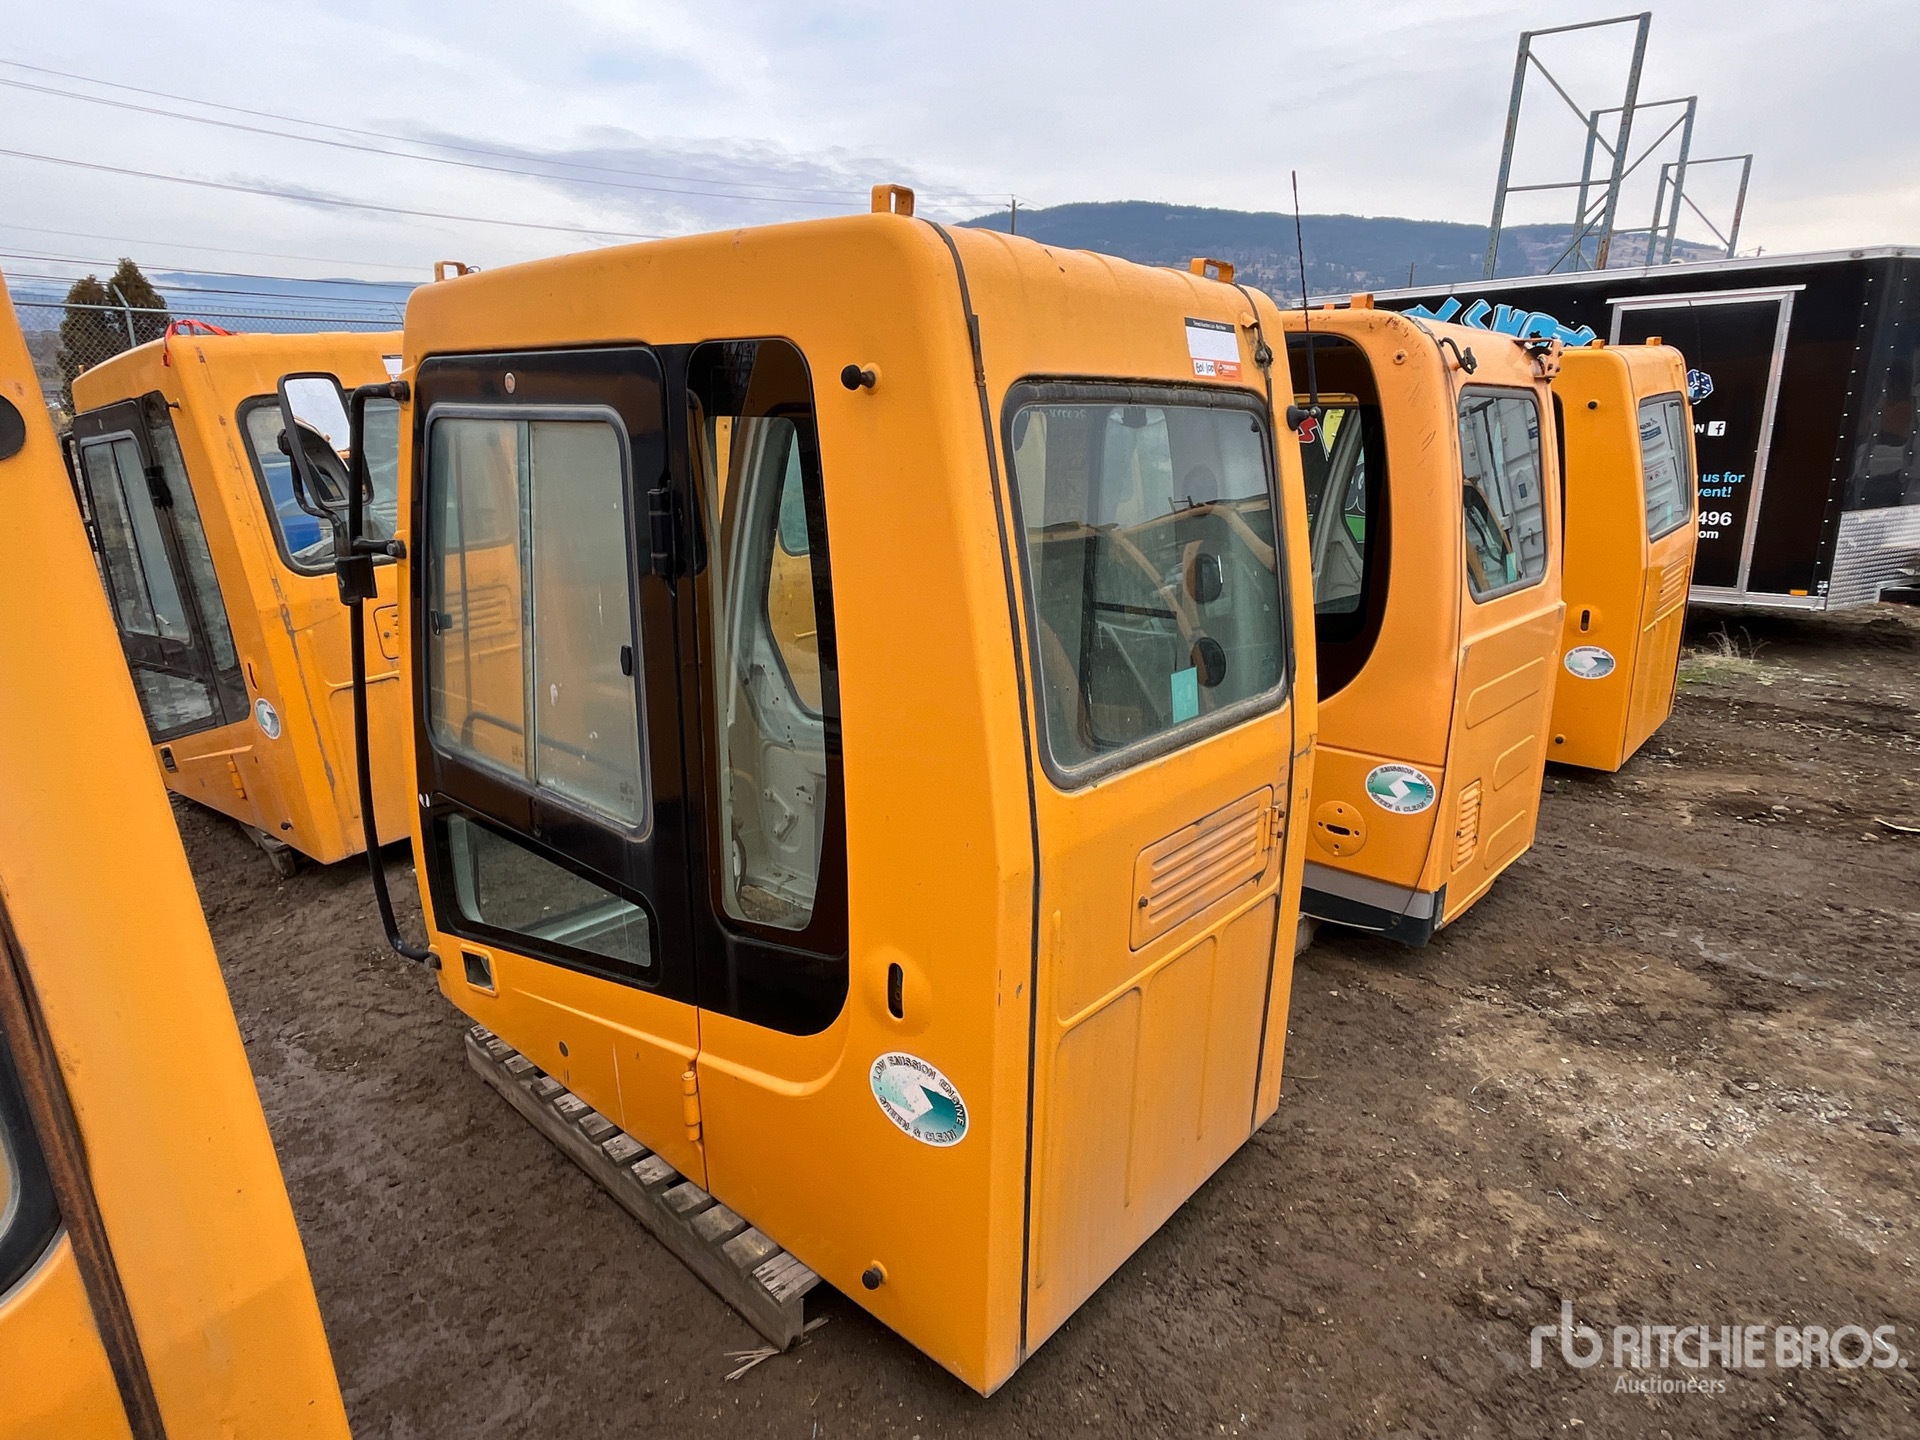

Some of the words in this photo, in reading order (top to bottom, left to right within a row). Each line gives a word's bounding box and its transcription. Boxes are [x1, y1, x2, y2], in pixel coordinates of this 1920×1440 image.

[1702, 473, 1719, 483] us
[1723, 471, 1745, 483] for
[1698, 511, 1733, 526] 496
[873, 1059, 887, 1081] LOW
[887, 1055, 936, 1080] EMISSION
[939, 1078, 966, 1128] ENGINE
[924, 1129, 957, 1143] CLEAN
